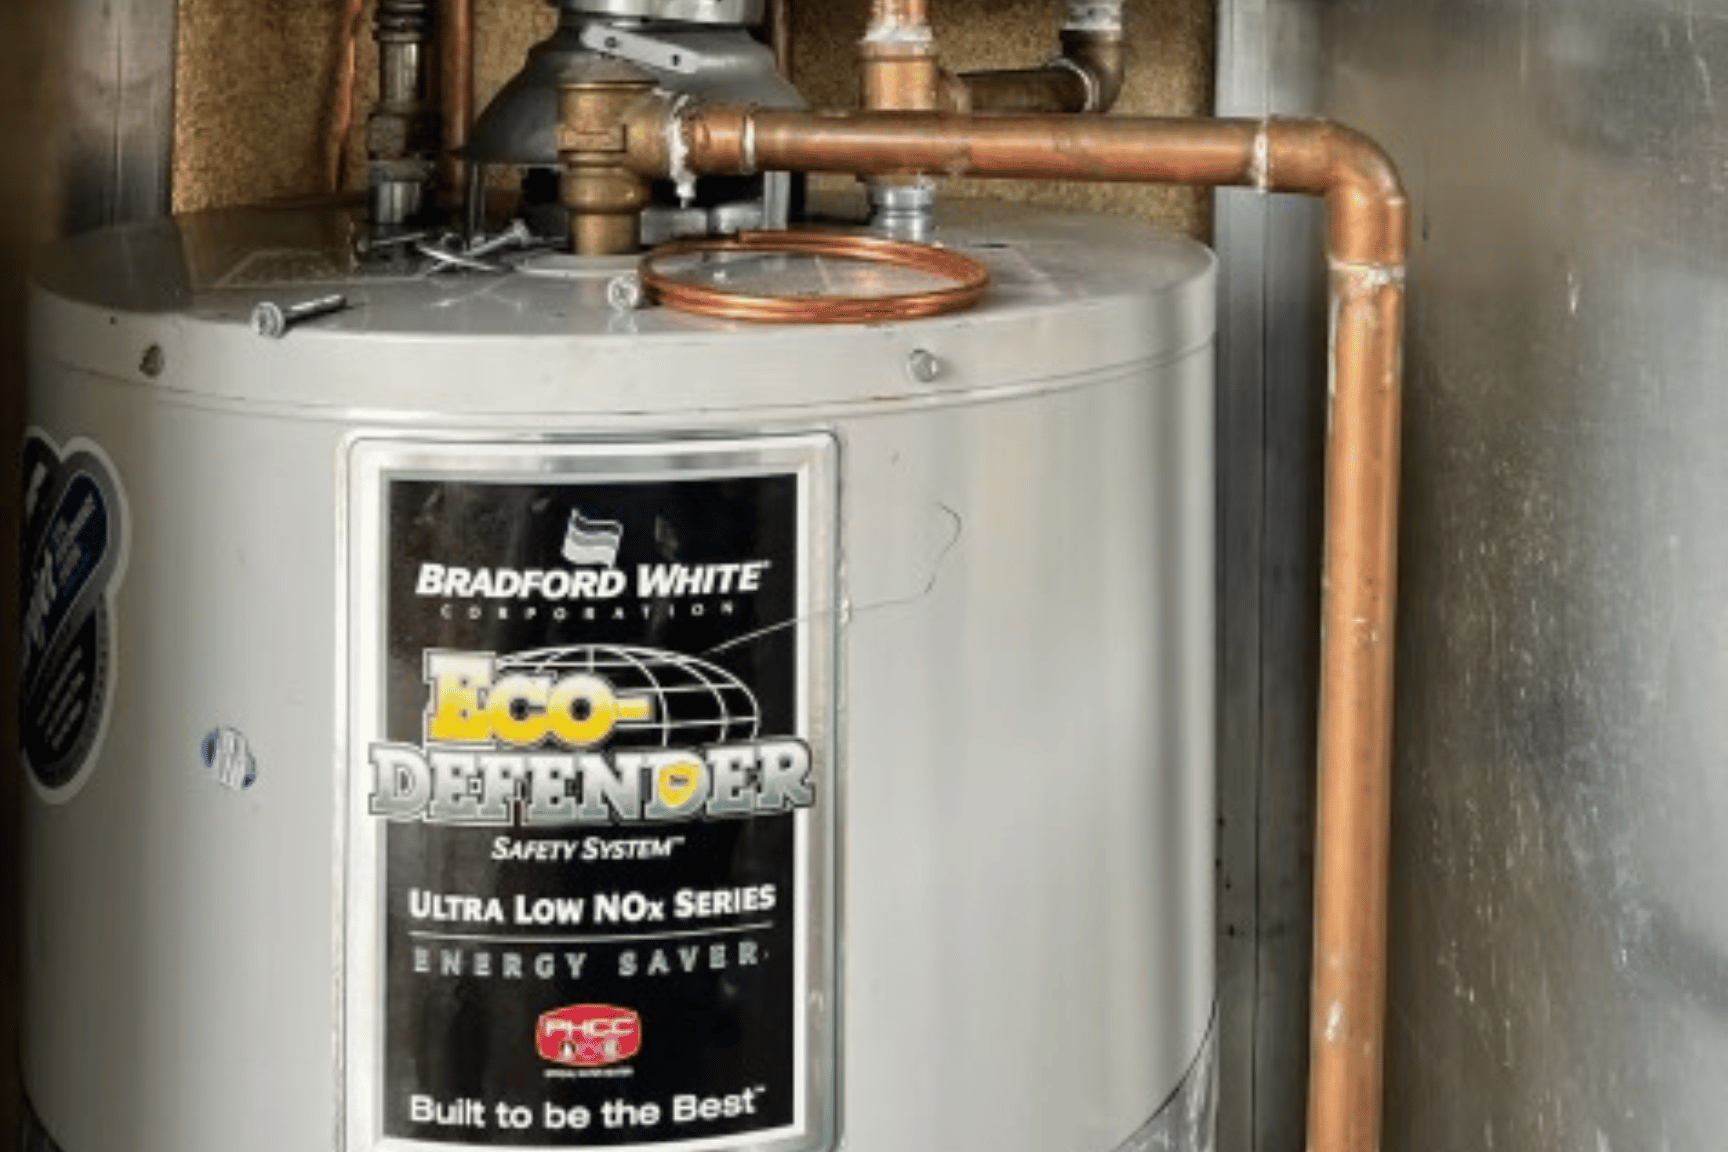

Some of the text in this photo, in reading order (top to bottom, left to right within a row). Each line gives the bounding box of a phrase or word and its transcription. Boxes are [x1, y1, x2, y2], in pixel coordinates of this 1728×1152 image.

[415, 562, 764, 599] BRADFORD WHITE
[440, 600, 734, 621] CORPORATION
[369, 737, 814, 826] DEFENDER
[491, 836, 674, 862] SAFETY SYSTEM
[409, 887, 504, 921] ULTRA
[514, 894, 585, 925] LOW
[674, 883, 777, 918] SERIES
[413, 941, 758, 979] ENERGY SAVER
[410, 1084, 757, 1129] Built to be the Best
